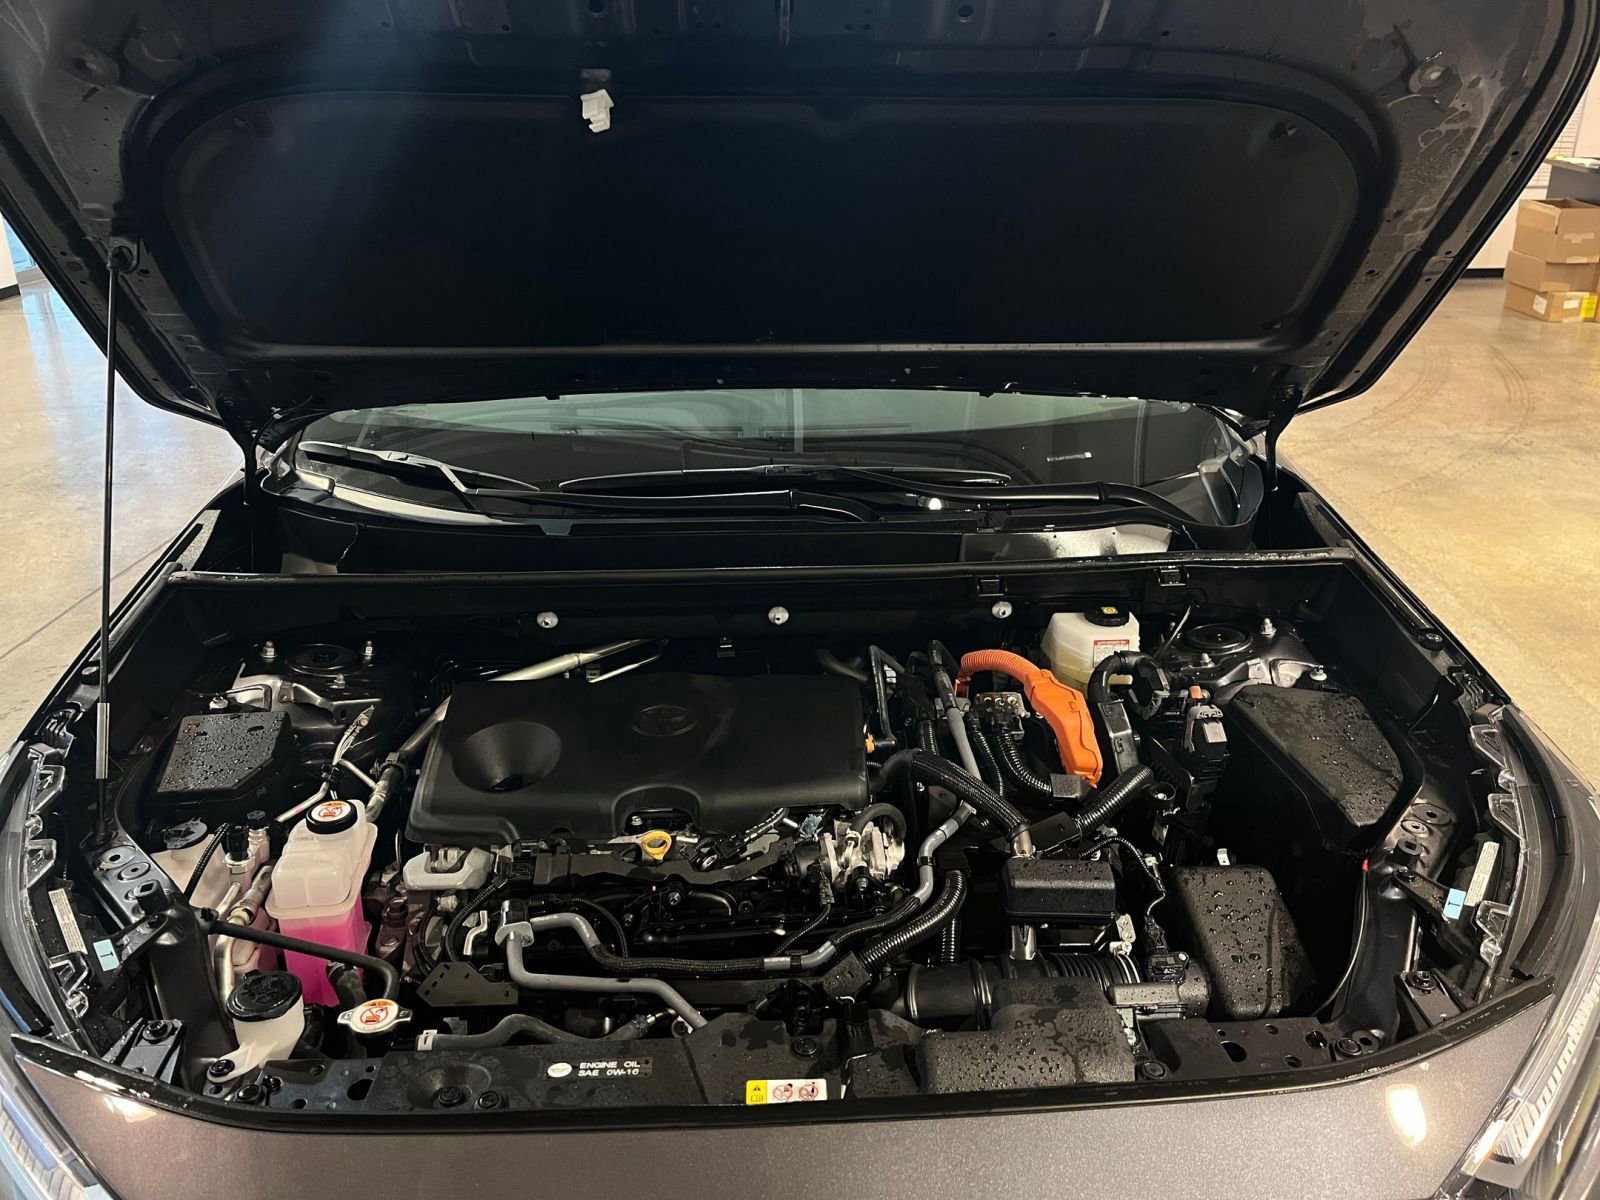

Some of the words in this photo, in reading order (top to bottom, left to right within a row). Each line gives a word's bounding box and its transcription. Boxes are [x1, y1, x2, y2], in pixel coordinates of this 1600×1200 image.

[579, 1061, 618, 1069] ENGINE
[623, 1060, 640, 1068] OIL
[578, 1069, 599, 1077] SAE
